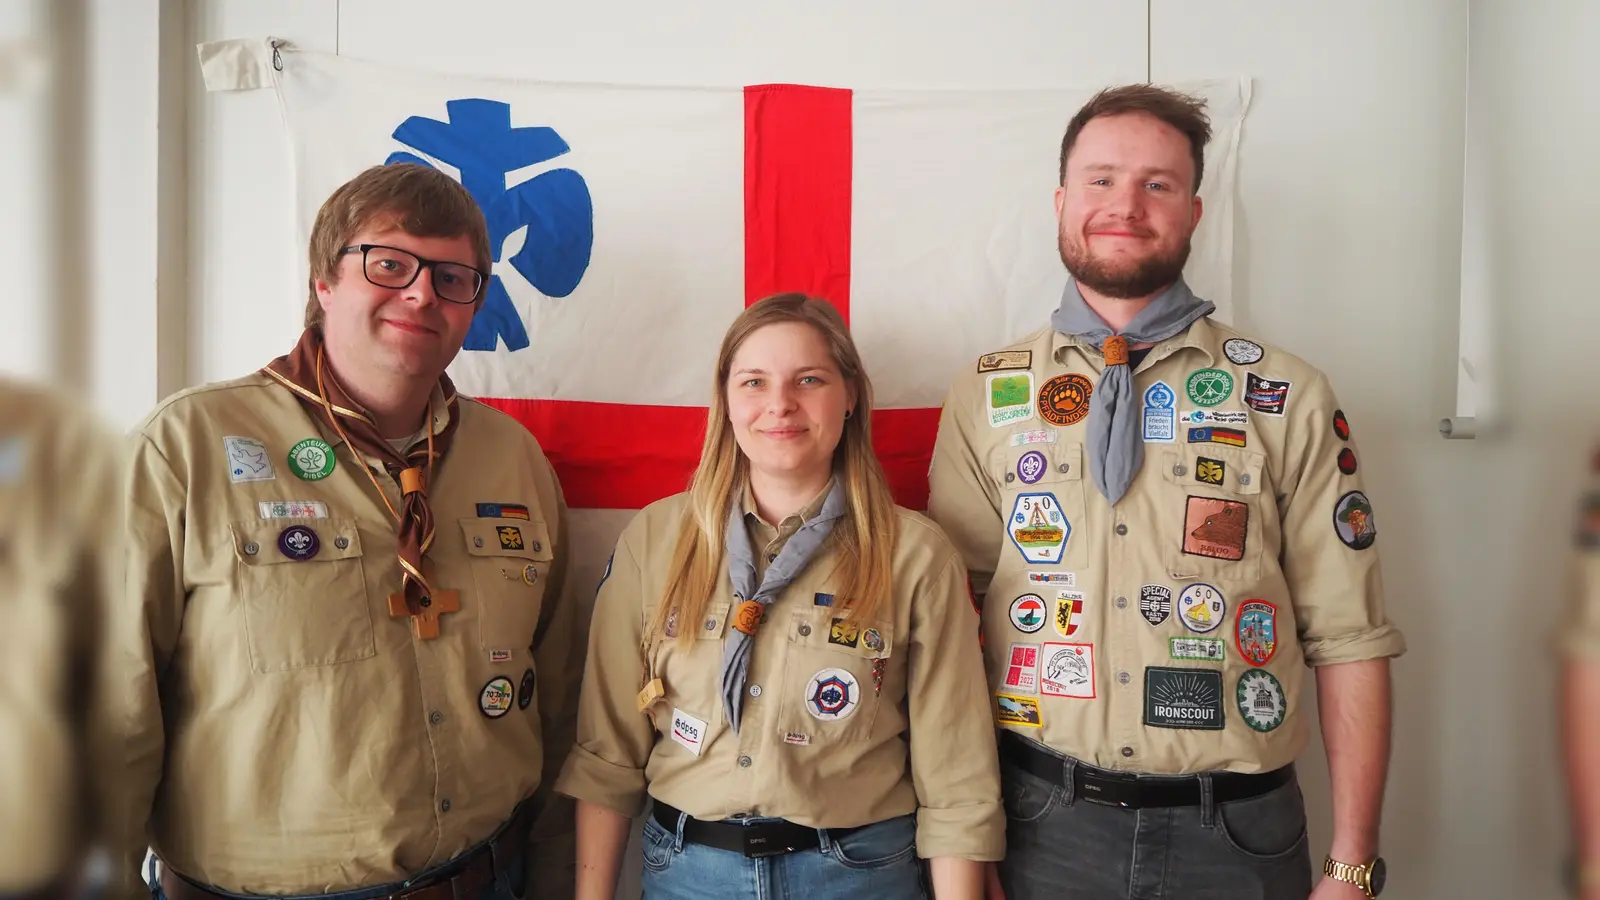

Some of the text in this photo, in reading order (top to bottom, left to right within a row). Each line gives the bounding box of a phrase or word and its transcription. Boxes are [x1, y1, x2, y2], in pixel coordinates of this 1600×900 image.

[290, 440, 330, 459] ABENTEUER
[303, 471, 327, 479] BIBEL
[1200, 544, 1229, 554] BALOO
[1142, 586, 1170, 599] SPECIAL
[1020, 676, 1034, 685] 2022
[1155, 705, 1215, 720] IRONSCOUT
[681, 720, 699, 739] dpsg
